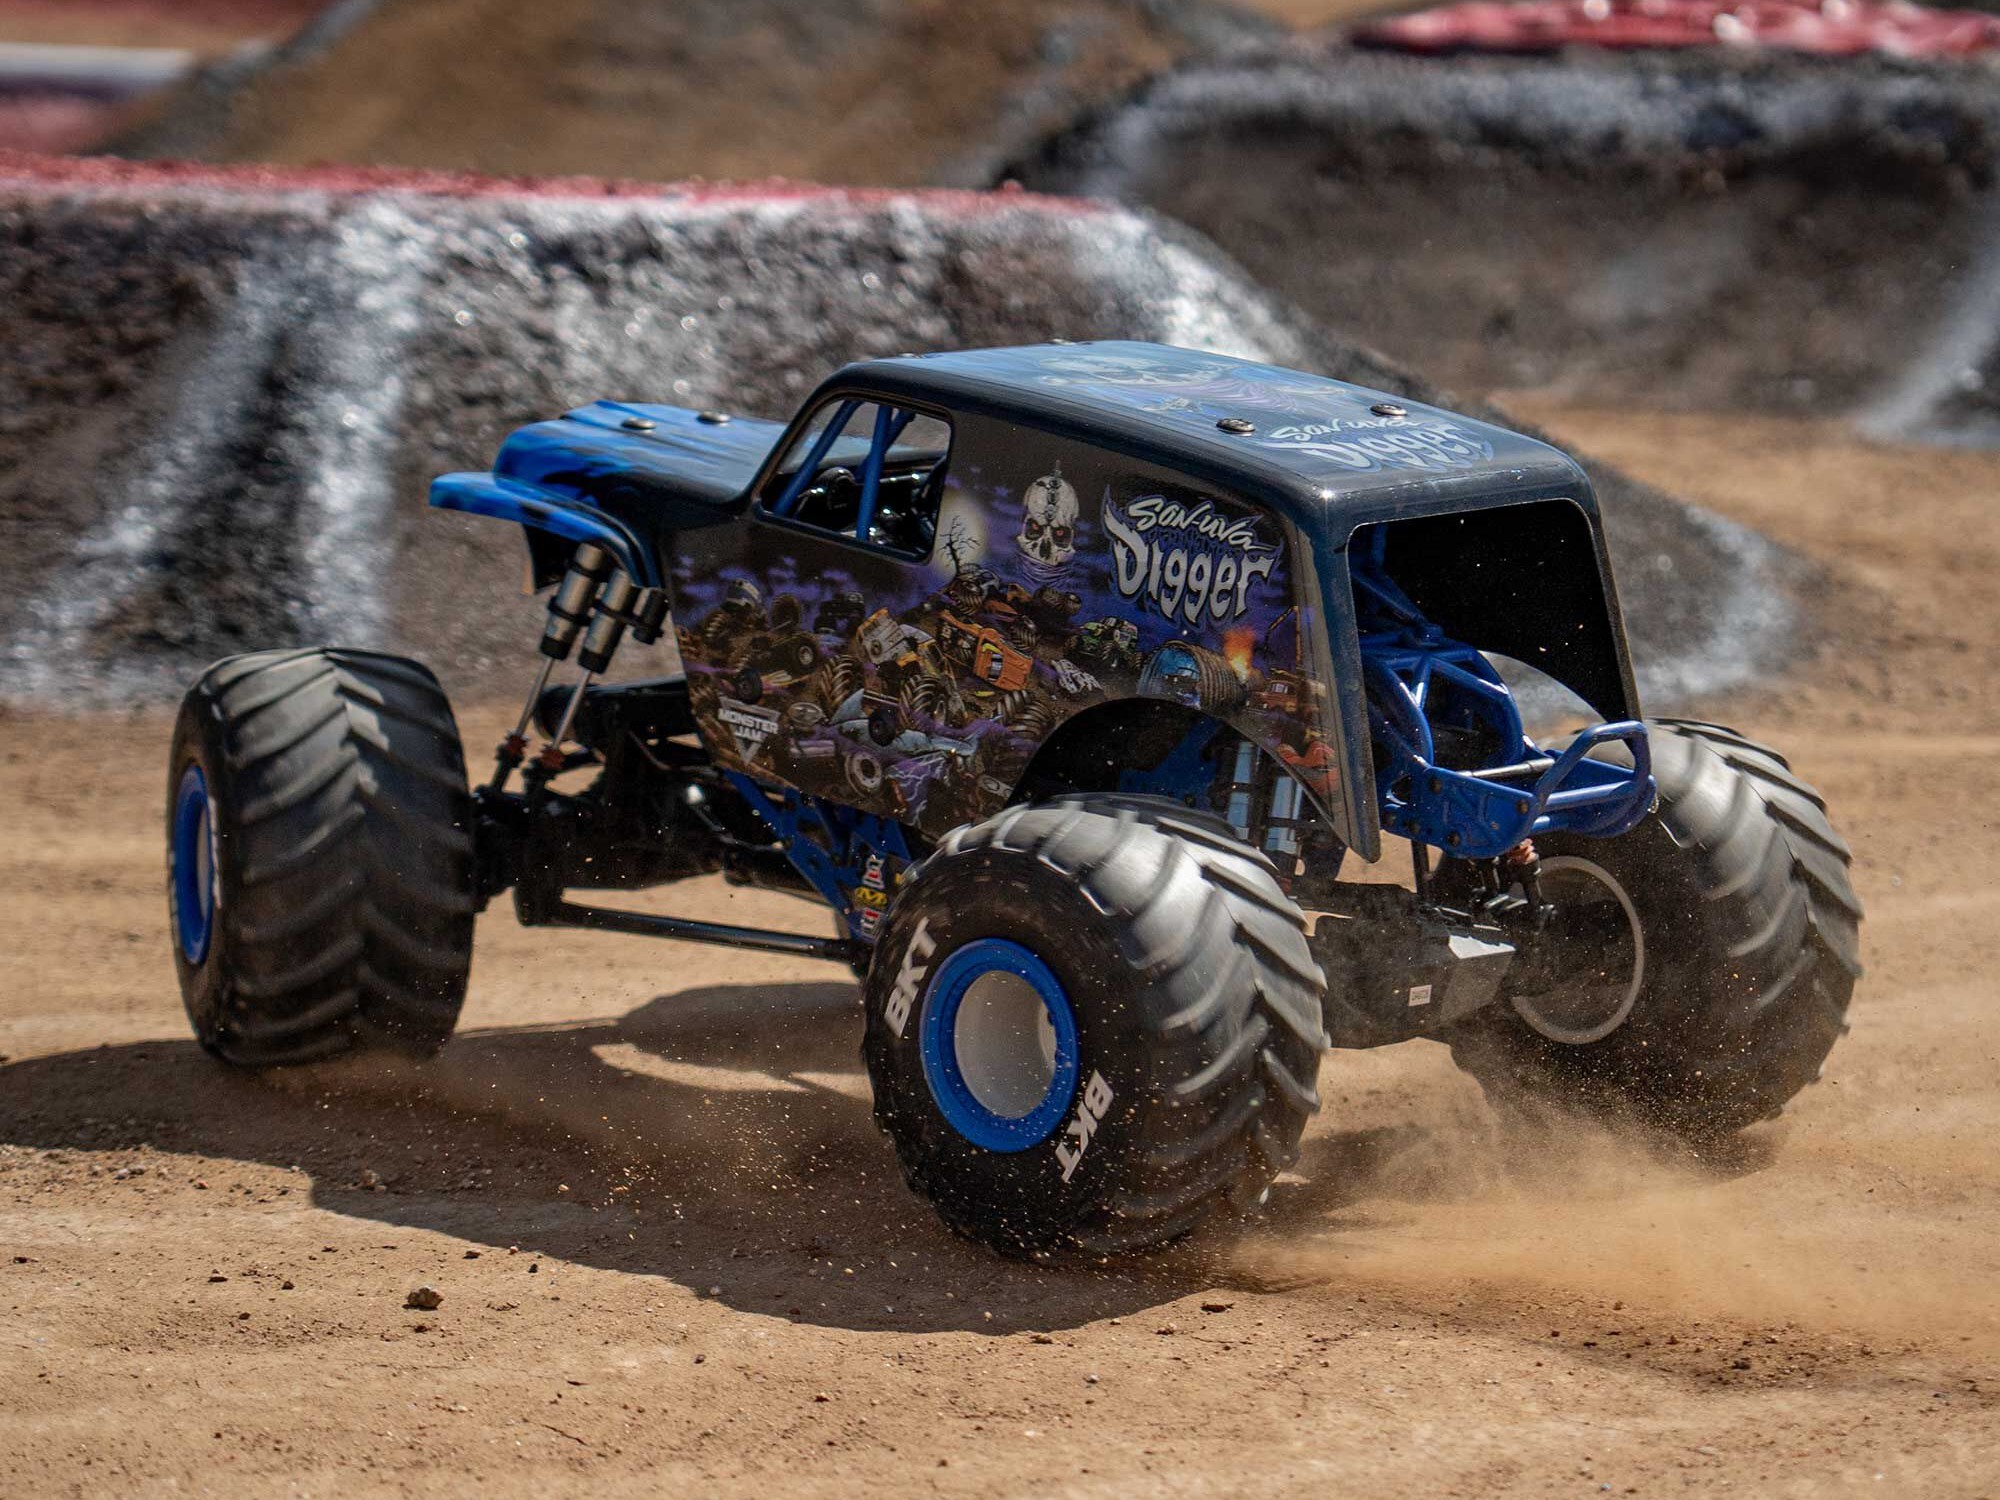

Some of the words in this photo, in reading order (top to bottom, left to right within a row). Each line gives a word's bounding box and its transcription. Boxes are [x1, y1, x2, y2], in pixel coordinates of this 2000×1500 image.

[717, 708, 779, 735] MONSTER
[734, 727, 766, 743] JAM
[883, 915, 937, 1039] BKT
[1054, 1068, 1114, 1184] BKT
